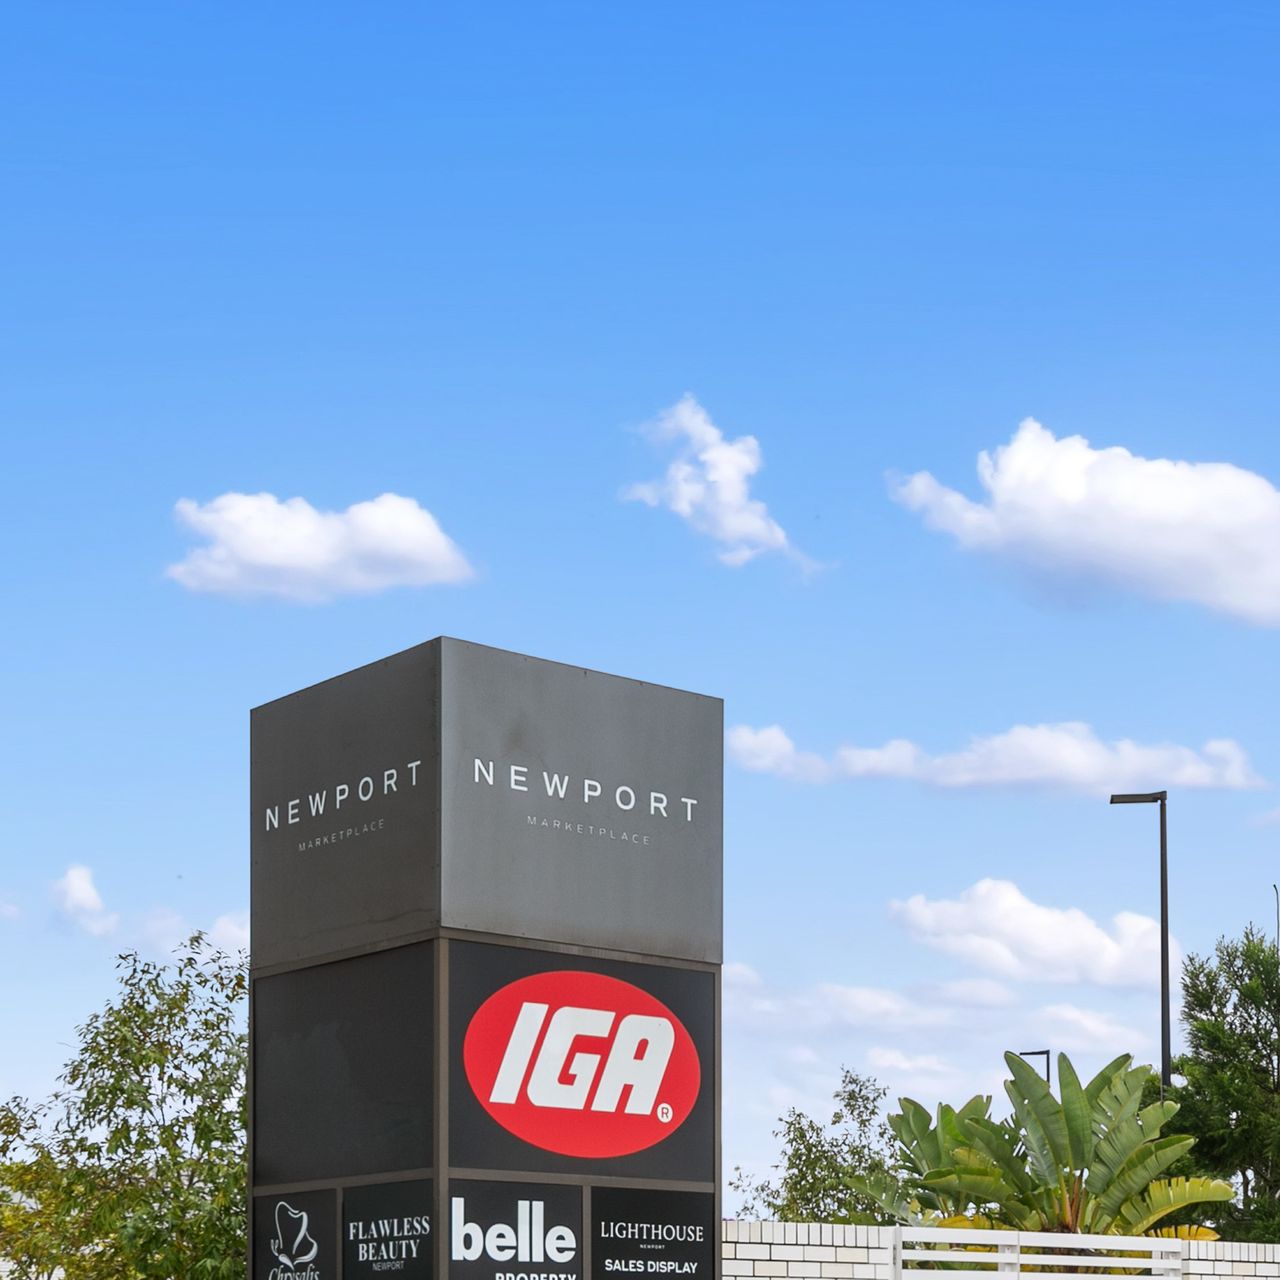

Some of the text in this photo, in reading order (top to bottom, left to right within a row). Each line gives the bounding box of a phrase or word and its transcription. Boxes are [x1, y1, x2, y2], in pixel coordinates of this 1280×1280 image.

[265, 760, 422, 831] NEWPORT
[474, 758, 698, 822] NEWPORT
[298, 818, 385, 851] MARKETPLACE
[526, 815, 651, 846] MARKETPLACE
[488, 1001, 675, 1116] IGA
[349, 1215, 431, 1241] FLAWLESS
[451, 1196, 577, 1263] belle
[600, 1221, 704, 1242] LIGHTHOUSE
[358, 1239, 420, 1262] BEAUTY
[372, 1260, 405, 1272] NEWPORT
[604, 1258, 698, 1275] SALES DISPLAY
